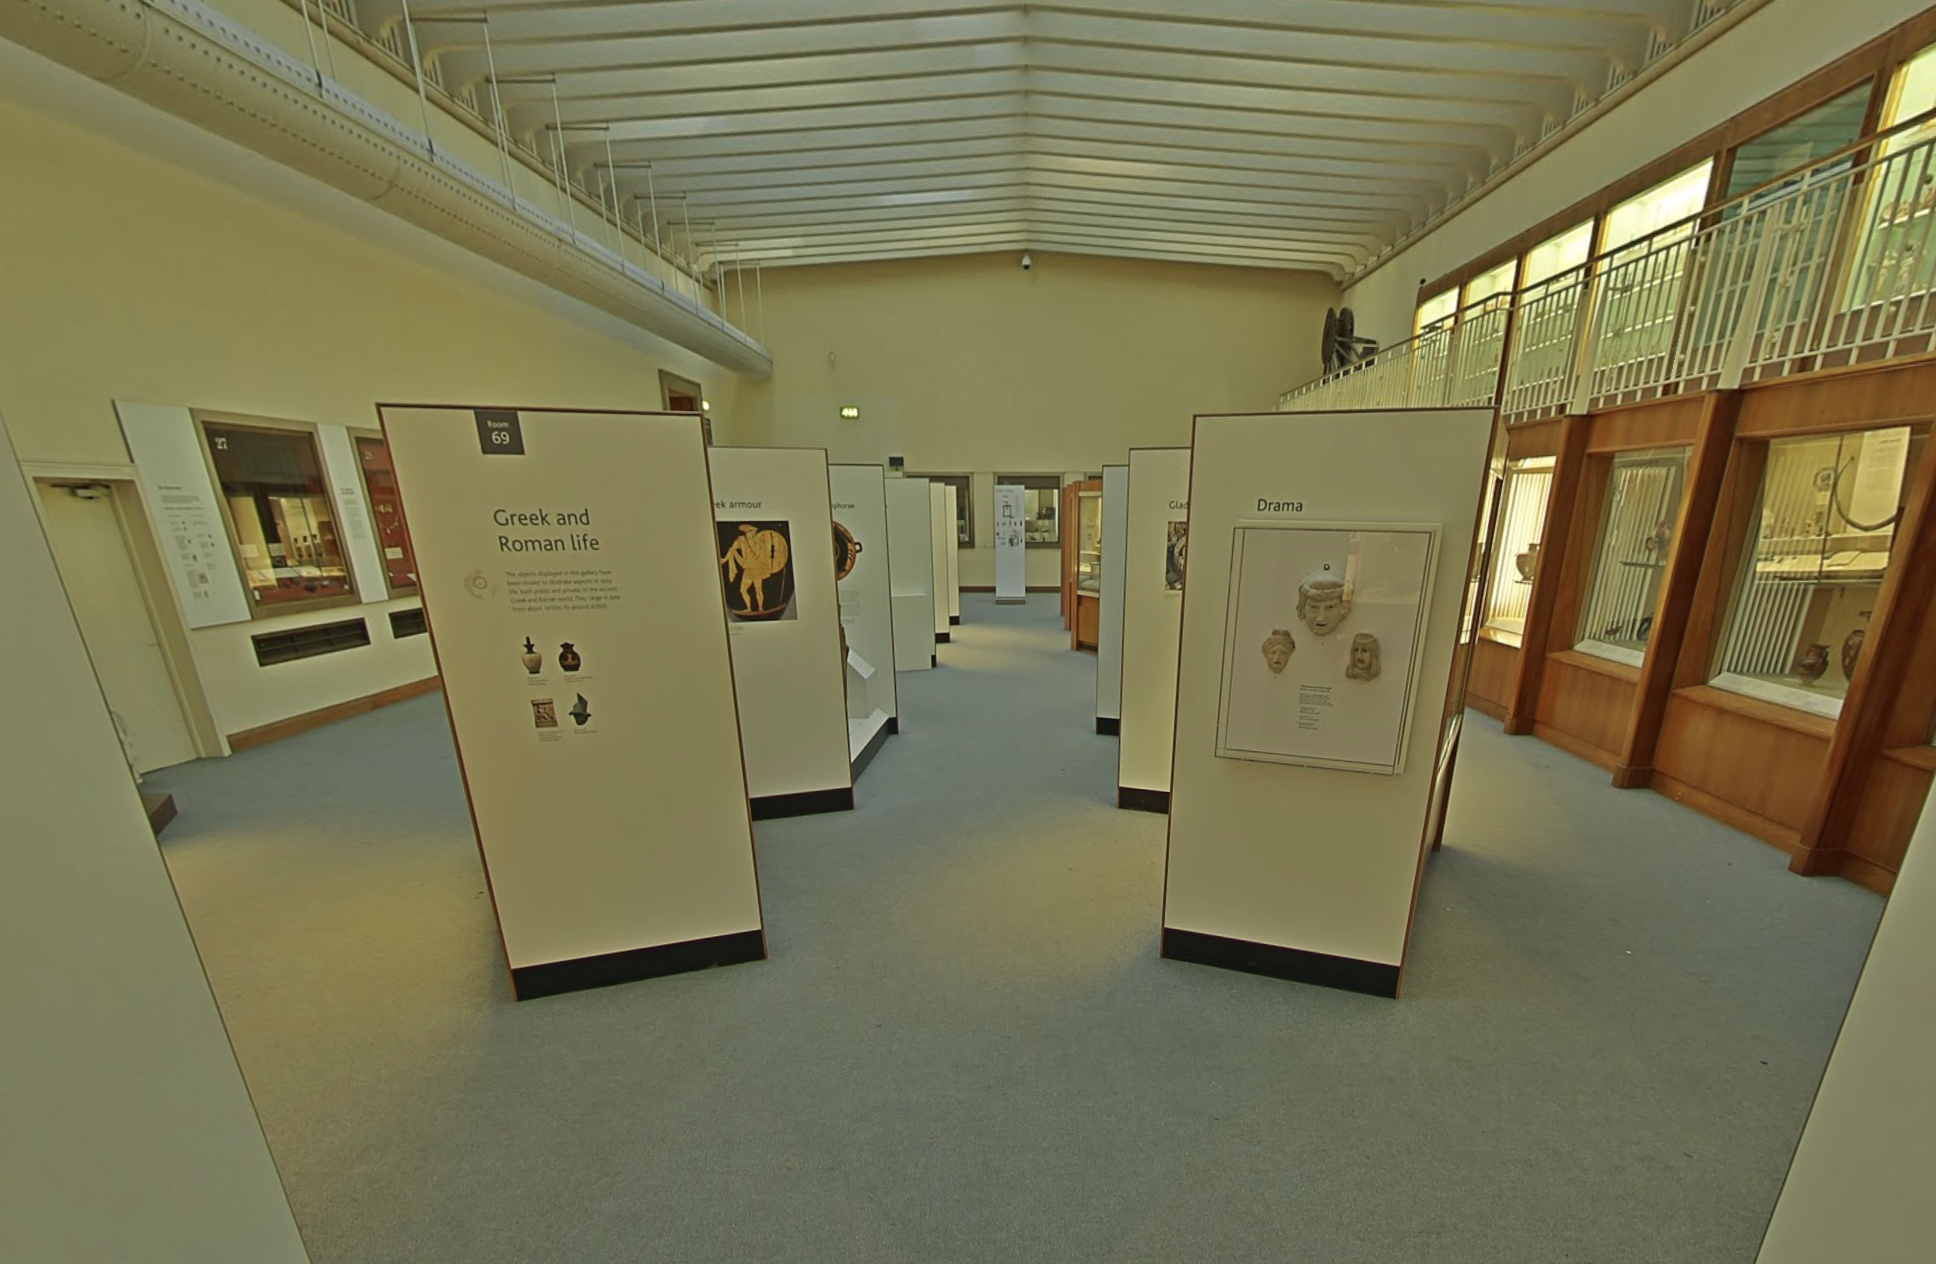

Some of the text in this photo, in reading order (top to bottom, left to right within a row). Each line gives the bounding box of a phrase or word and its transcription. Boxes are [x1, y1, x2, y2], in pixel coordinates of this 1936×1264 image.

[487, 420, 510, 428] Room
[214, 437, 228, 450] 27
[491, 431, 510, 445] 69
[729, 501, 762, 509] armour
[831, 501, 855, 510] phorae
[1257, 498, 1303, 512] Drama
[493, 507, 590, 526] Greek and
[498, 533, 600, 552] Roman life
